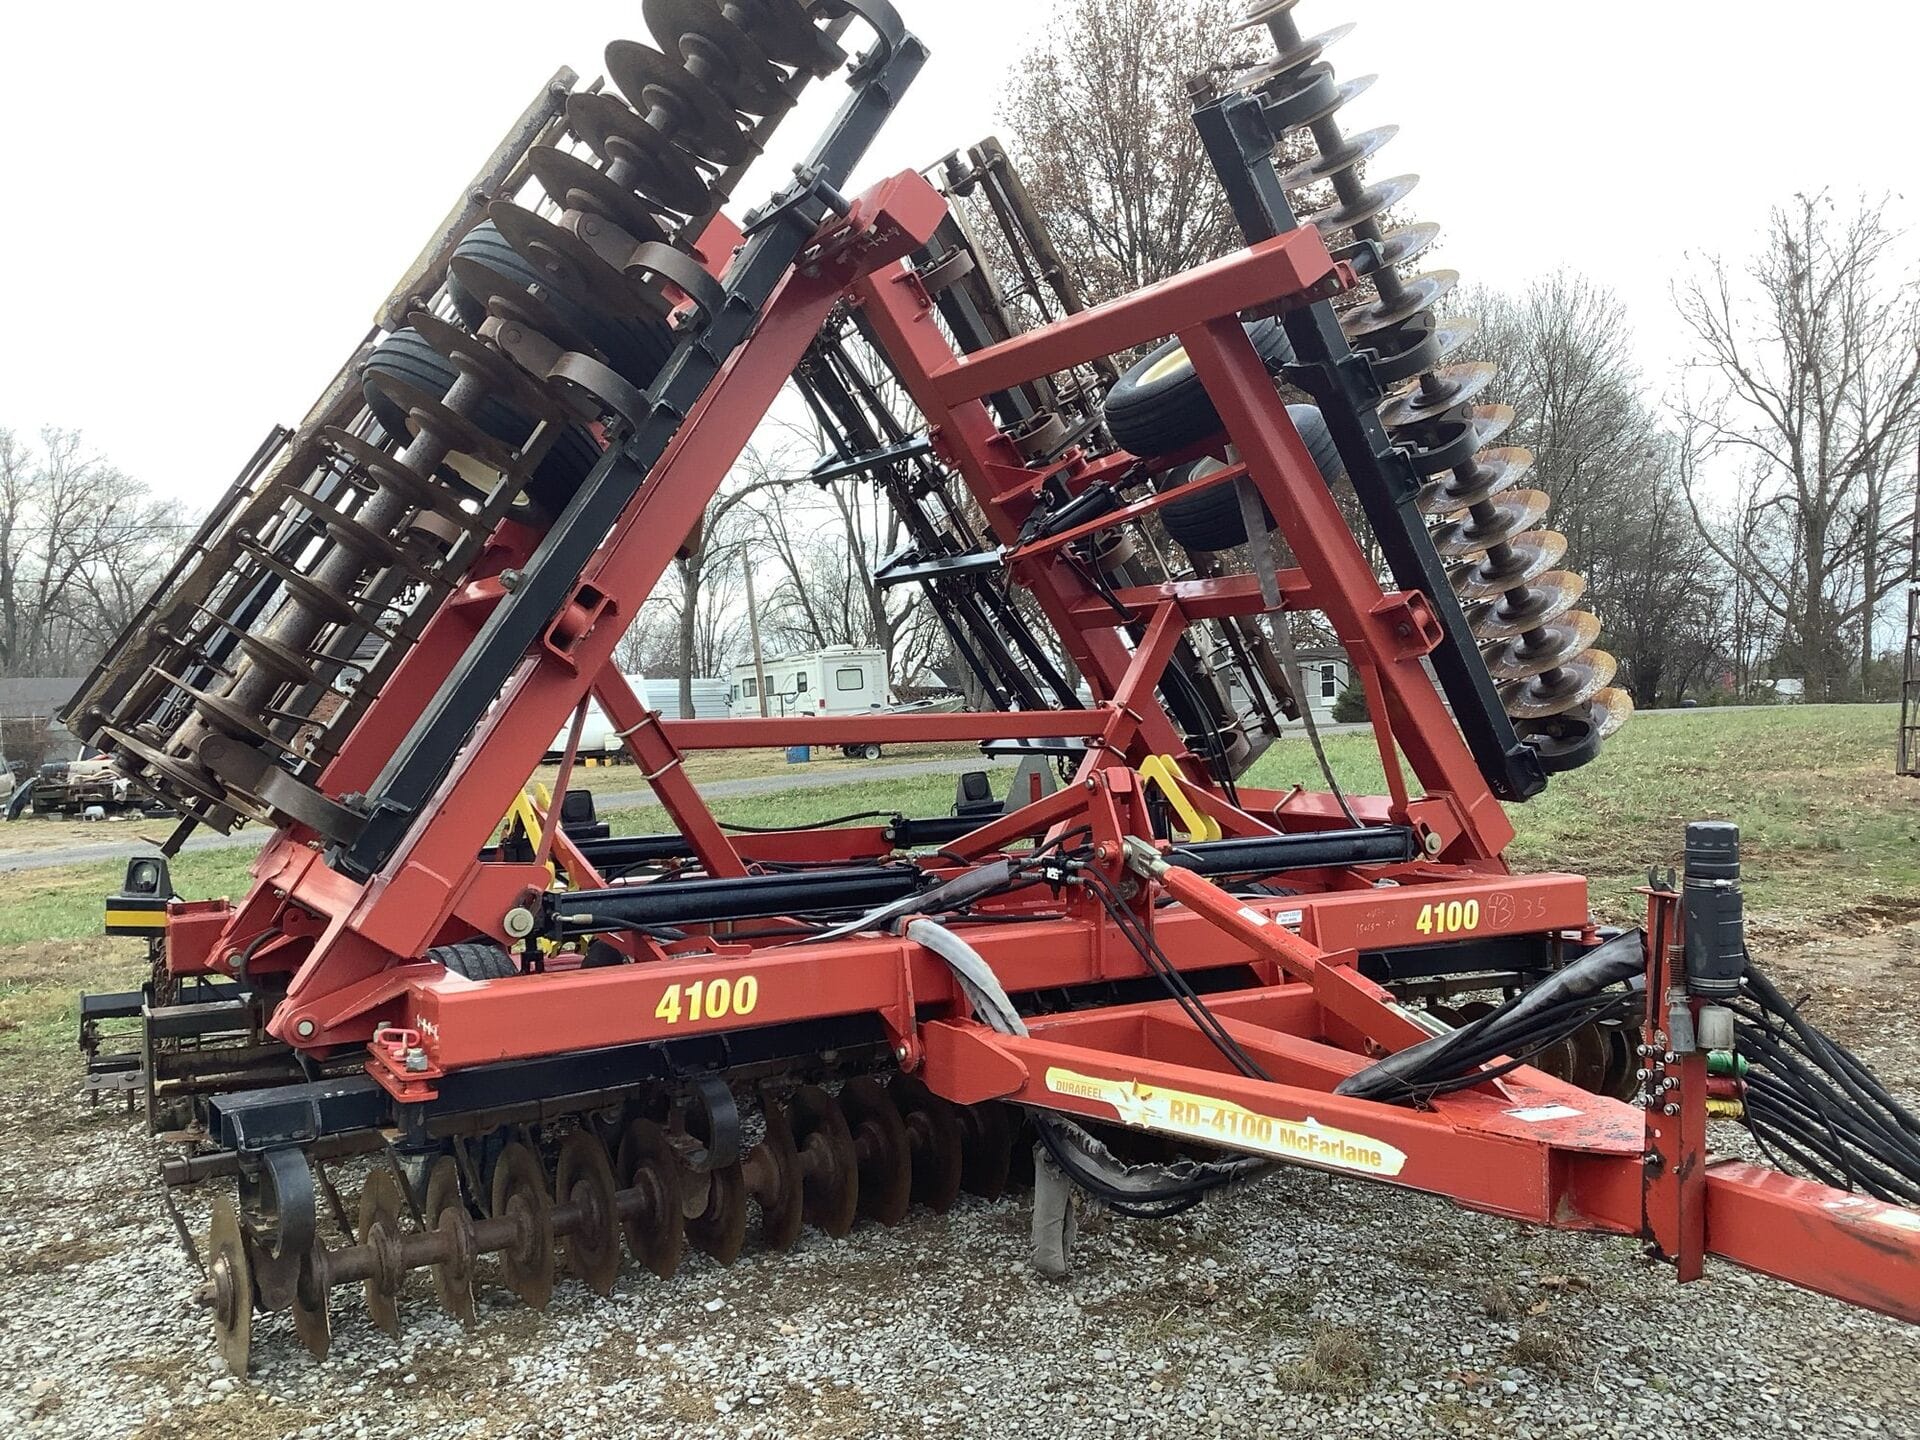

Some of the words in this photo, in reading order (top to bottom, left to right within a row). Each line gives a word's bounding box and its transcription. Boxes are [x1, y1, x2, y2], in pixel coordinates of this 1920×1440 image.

[1415, 899, 1480, 935] 4100
[1520, 896, 1547, 920] 35
[654, 974, 759, 1025] 4100
[1055, 1080, 1104, 1099] DURAREEL
[1168, 1099, 1273, 1144] RD-4100
[1279, 1125, 1383, 1168] McFarlane
